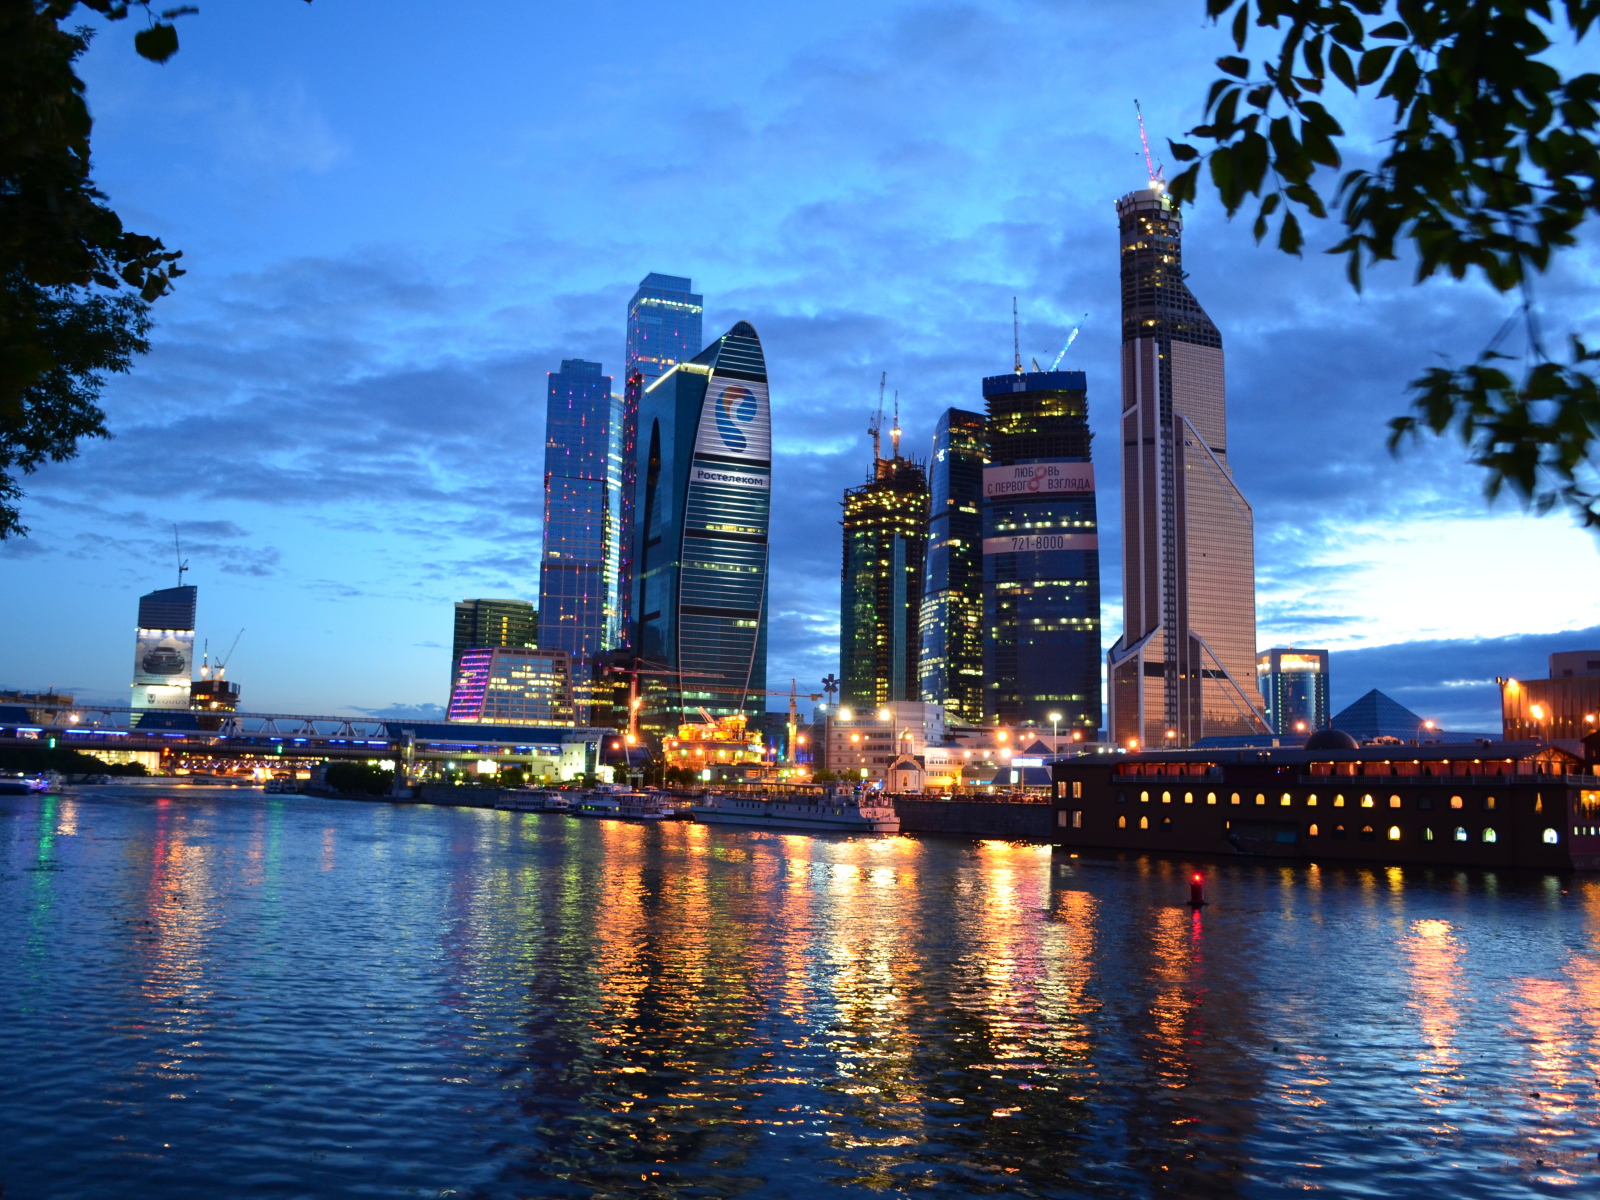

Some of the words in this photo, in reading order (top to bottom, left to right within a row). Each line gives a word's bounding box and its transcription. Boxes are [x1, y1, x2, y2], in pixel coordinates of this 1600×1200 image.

[697, 470, 763, 486] Ростелеком
[987, 483, 993, 494] С
[1047, 478, 1091, 491] ВЗГЛЯДА
[1011, 536, 1064, 551] 721-8000
